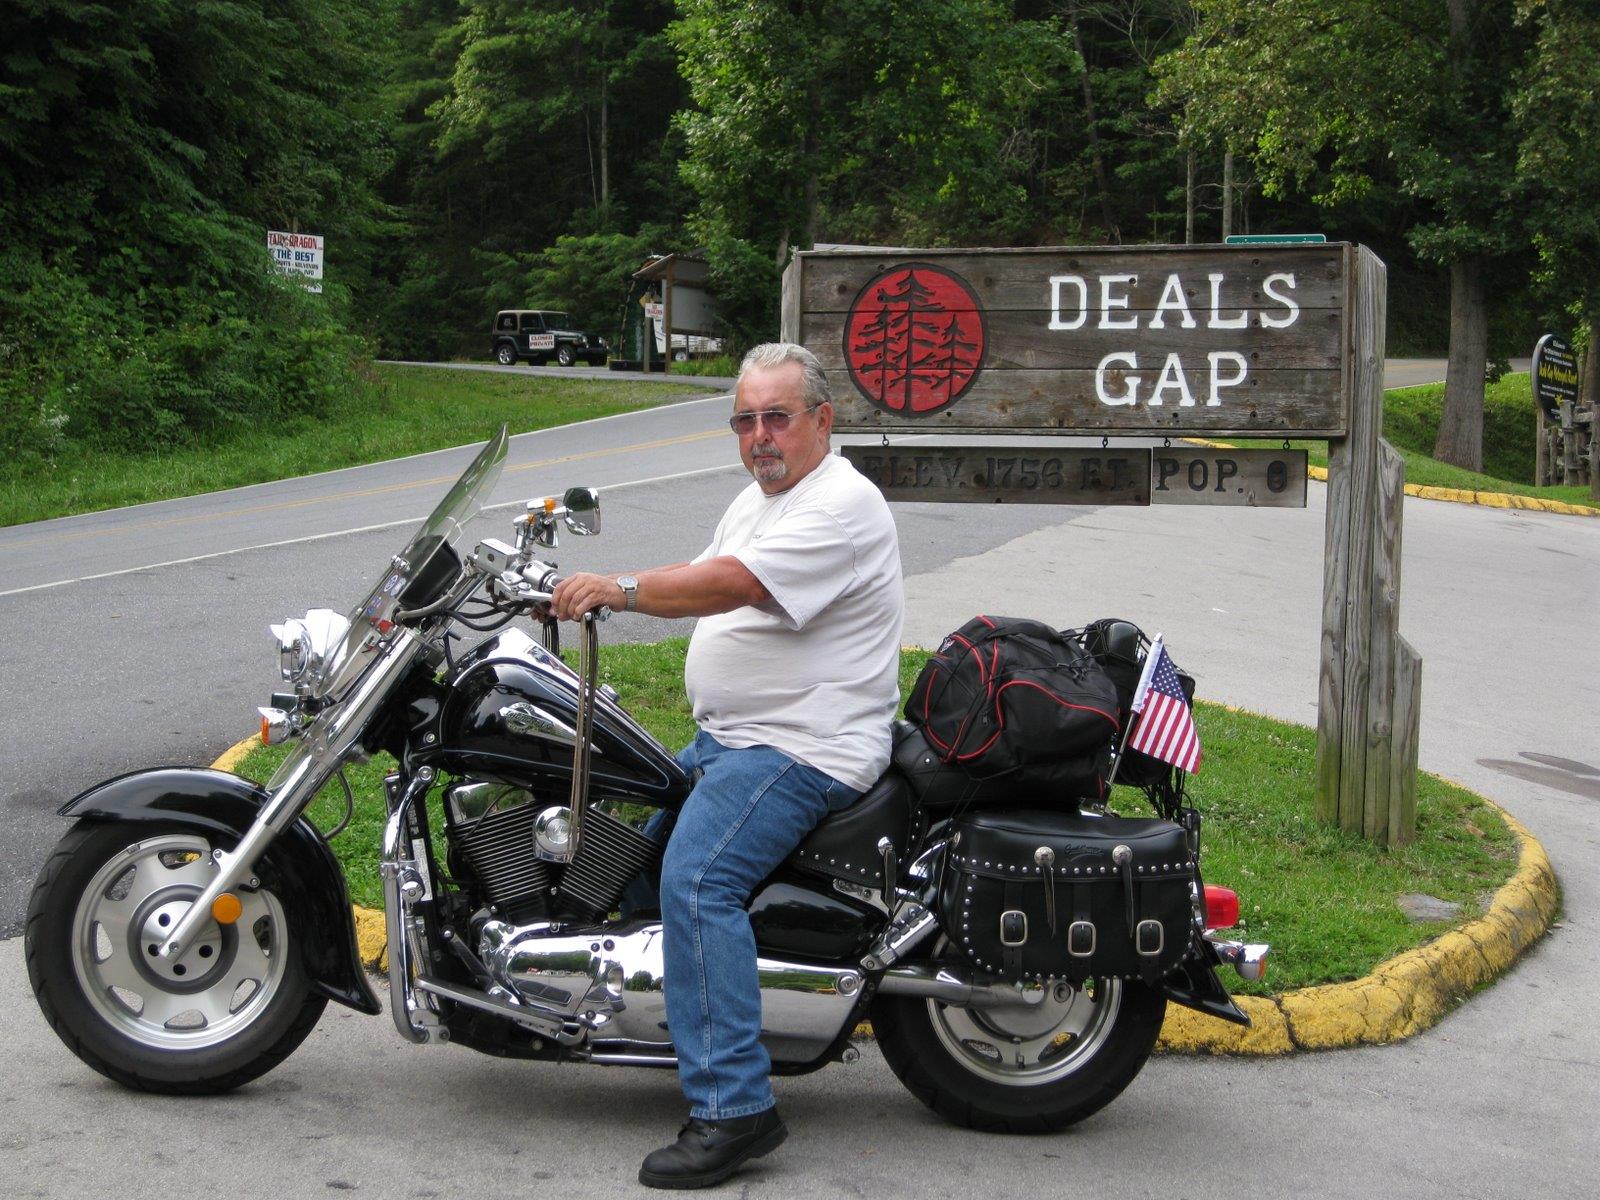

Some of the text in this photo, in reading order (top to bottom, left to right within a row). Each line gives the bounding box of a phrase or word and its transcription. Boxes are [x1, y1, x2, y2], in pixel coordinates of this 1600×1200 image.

[277, 249, 315, 262] THE BEST
[290, 235, 317, 249] DRAGON
[1048, 273, 1300, 330] DEALS
[1095, 351, 1248, 406] GAP
[863, 456, 1136, 492] ELEV. 1756 FT.
[1155, 458, 1244, 494] POP.
